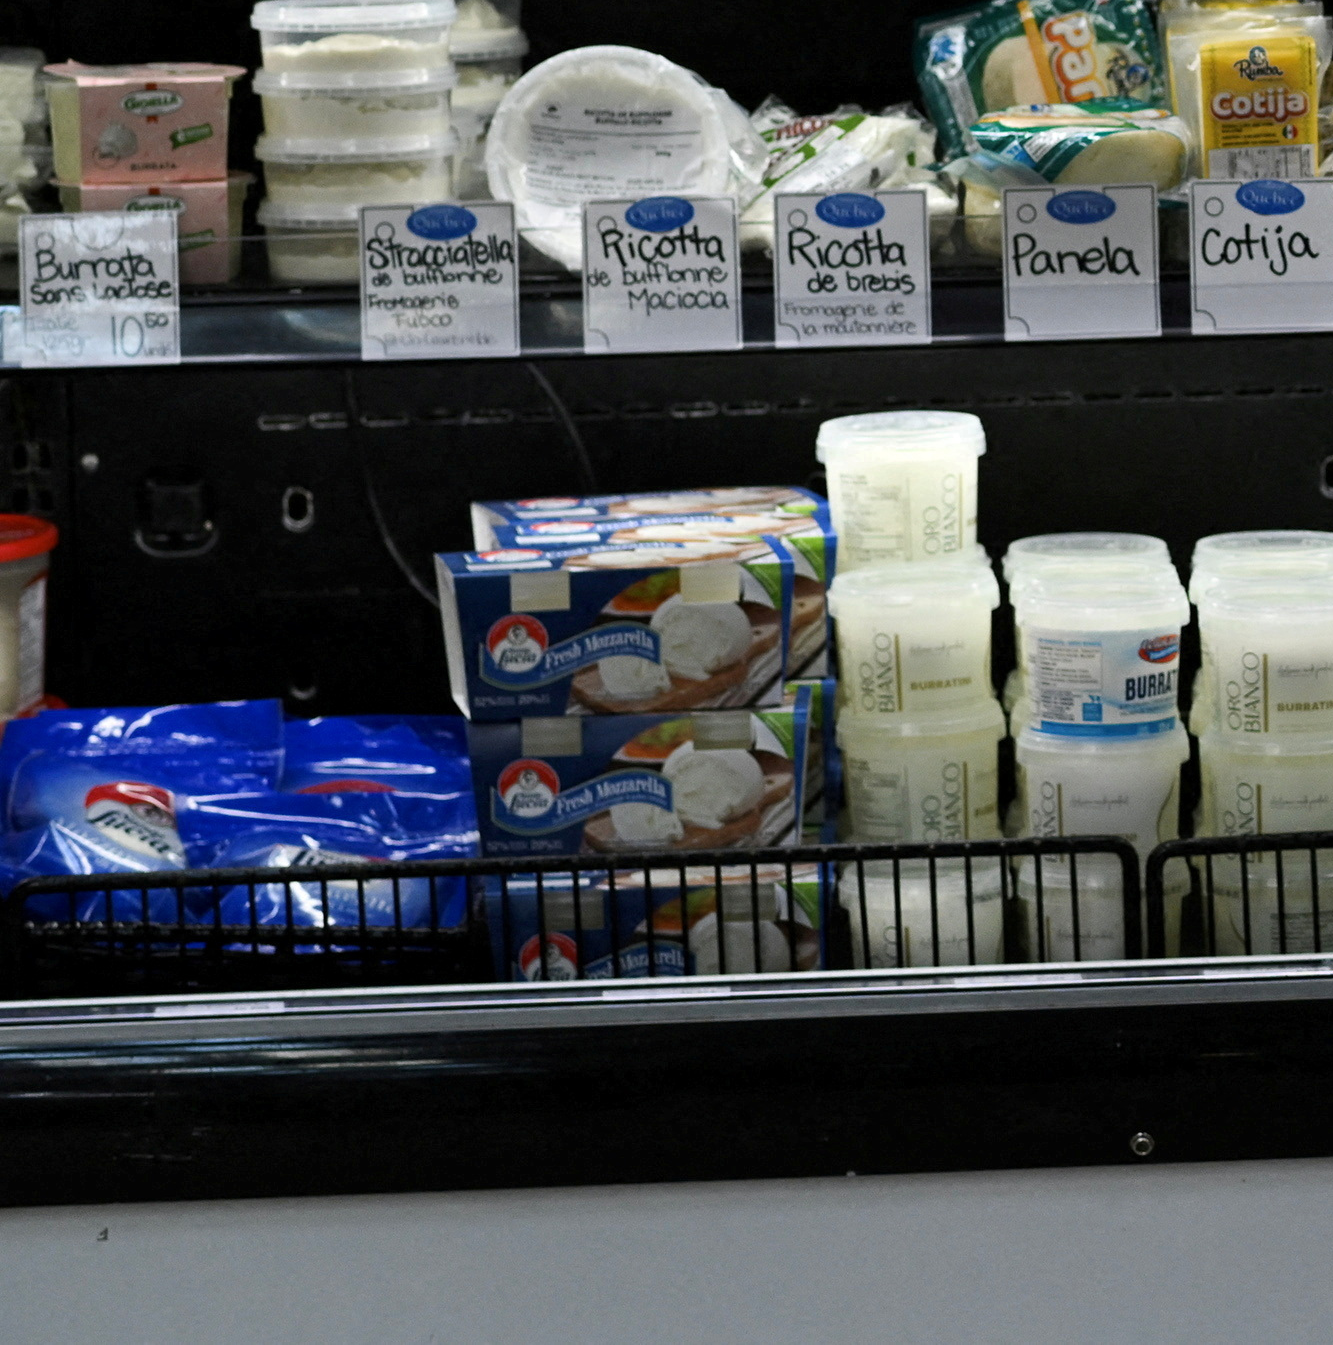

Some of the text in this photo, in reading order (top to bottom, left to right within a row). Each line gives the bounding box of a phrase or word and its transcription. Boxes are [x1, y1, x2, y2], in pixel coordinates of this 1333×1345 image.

[1233, 58, 1284, 82] Rumba
[1210, 89, 1309, 122] Cotija
[34, 247, 157, 284] Burrata
[366, 233, 514, 270] Stracciatella
[601, 225, 726, 267] Ricotta
[787, 227, 907, 270] Ricotta
[1011, 233, 1141, 277] Panela
[1200, 223, 1320, 276] Cotija
[30, 282, 87, 305] Sans
[587, 268, 612, 288] de
[807, 269, 916, 295] de brebis
[110, 315, 144, 358] 10
[544, 629, 655, 670] Fresh Mozzarella
[858, 660, 876, 713] ORO
[910, 676, 973, 692] BURRATINI
[1242, 651, 1262, 733] BIANCO
[1225, 680, 1243, 732] ORO
[555, 773, 666, 815] Fresh Mozzarella
